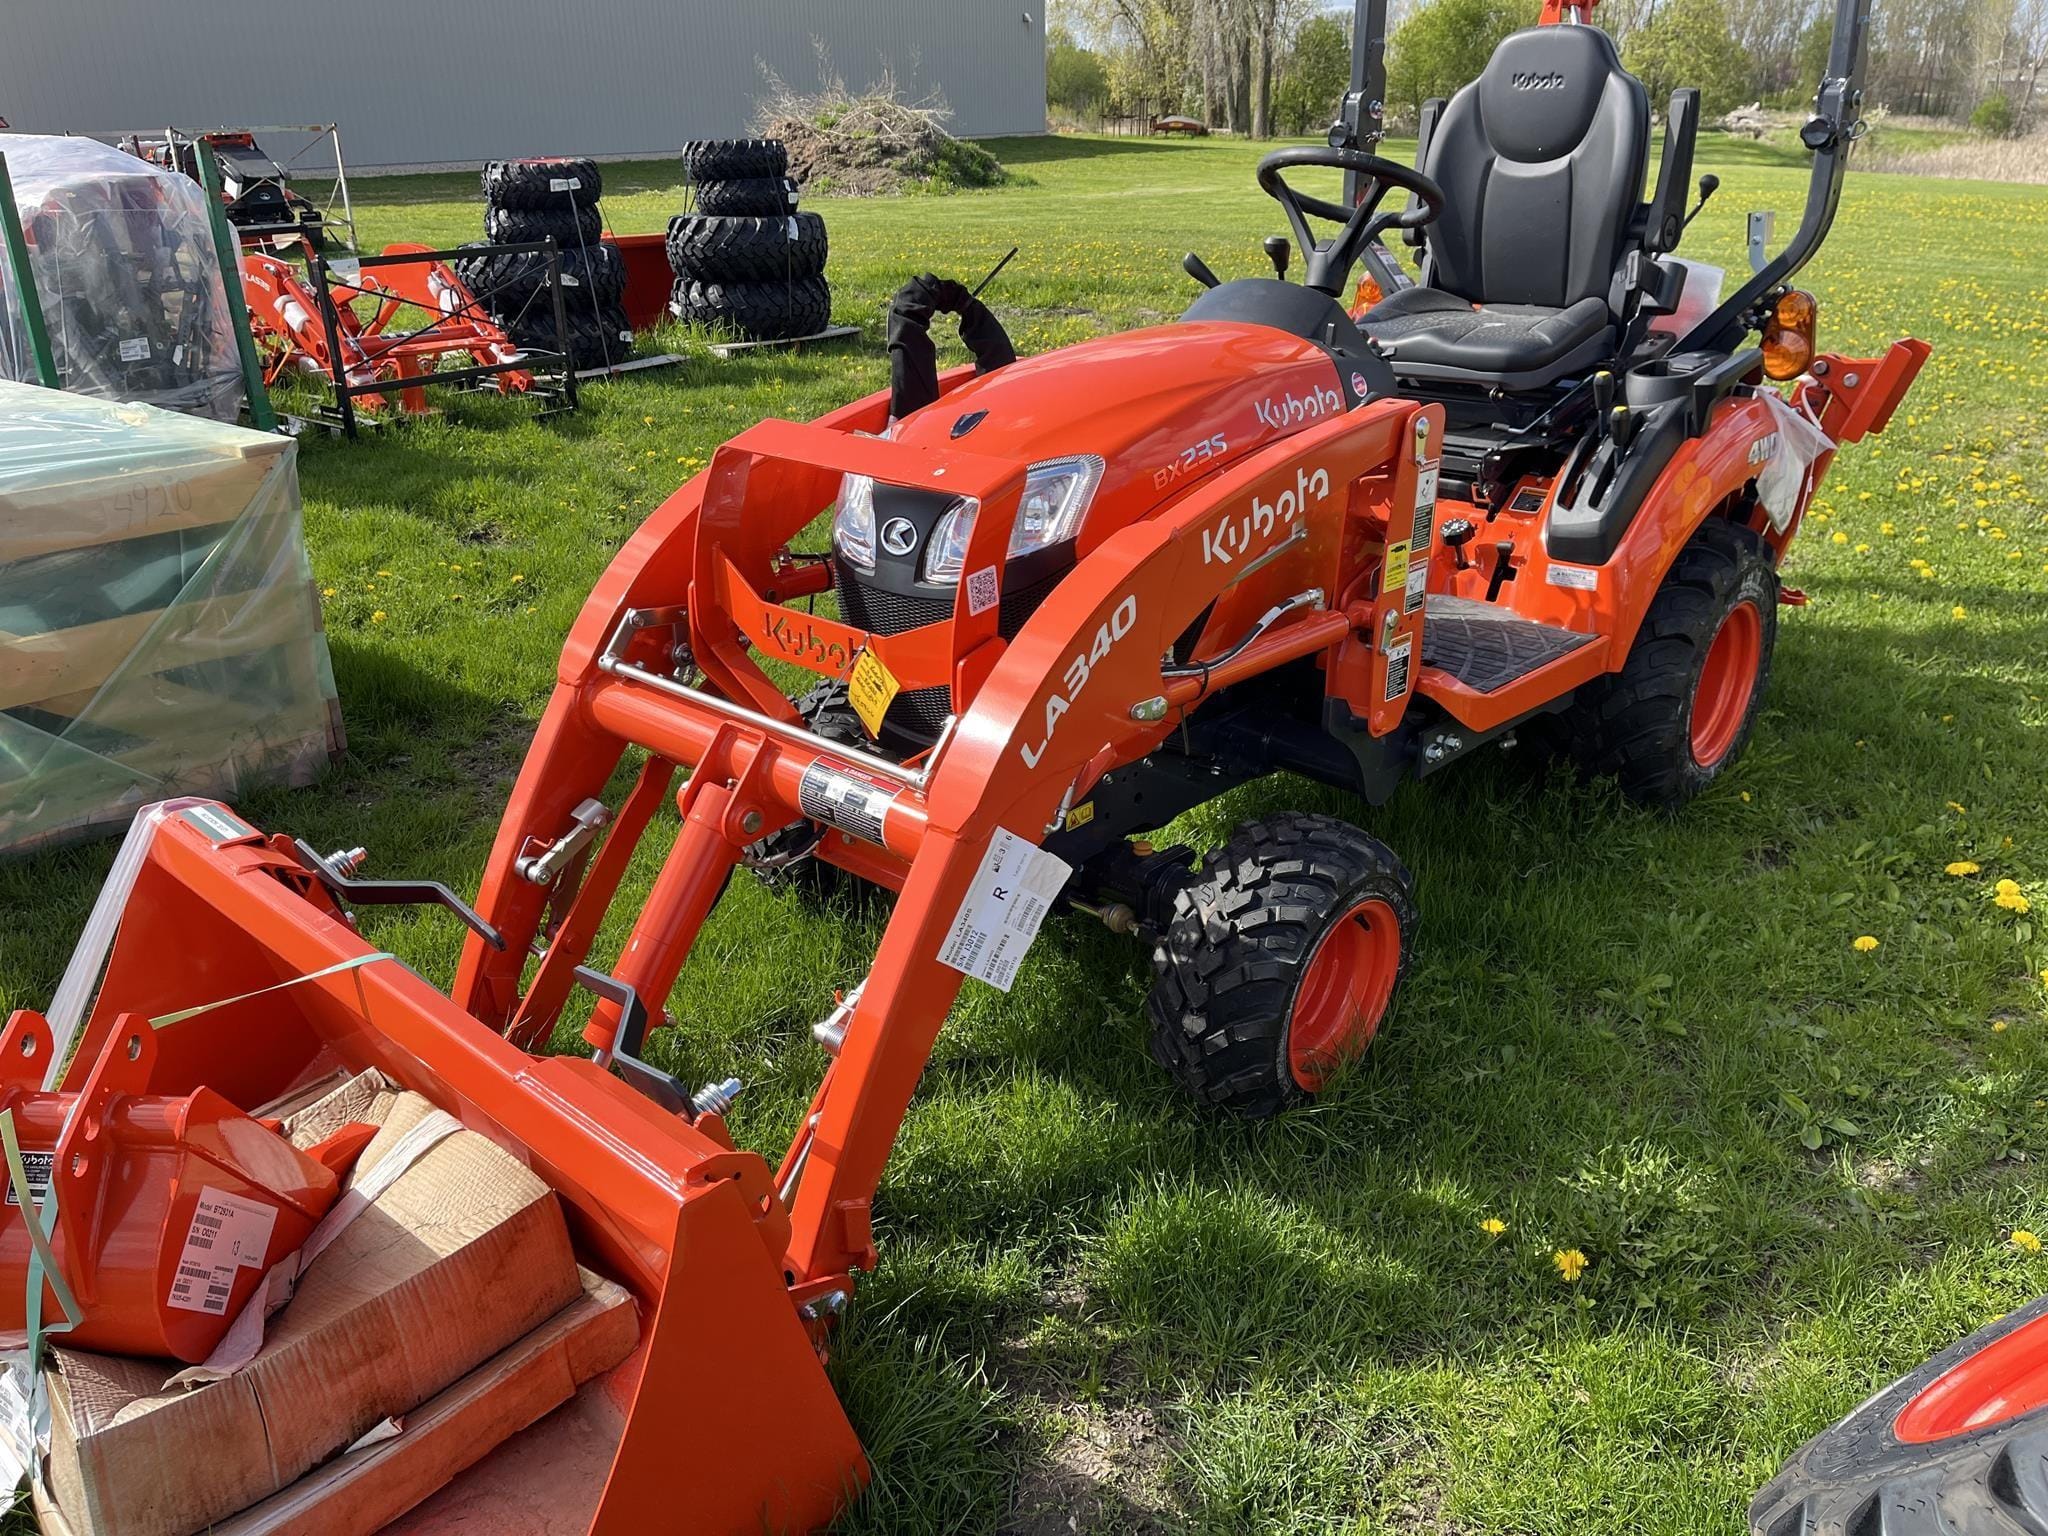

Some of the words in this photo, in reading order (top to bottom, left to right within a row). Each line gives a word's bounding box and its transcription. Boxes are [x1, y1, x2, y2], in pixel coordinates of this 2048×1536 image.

[1512, 72, 1564, 90] Kubota
[1255, 385, 1340, 428] Kubota
[1153, 432, 1228, 490] BX23S
[1203, 467, 1329, 564] Kubota
[766, 612, 857, 673] Kubot
[1020, 594, 1137, 769] LA340
[992, 886, 1009, 901] R
[945, 941, 958, 961] Model
[956, 908, 972, 938] LA340S
[956, 954, 967, 967] S/N
[200, 1201, 213, 1211] Model
